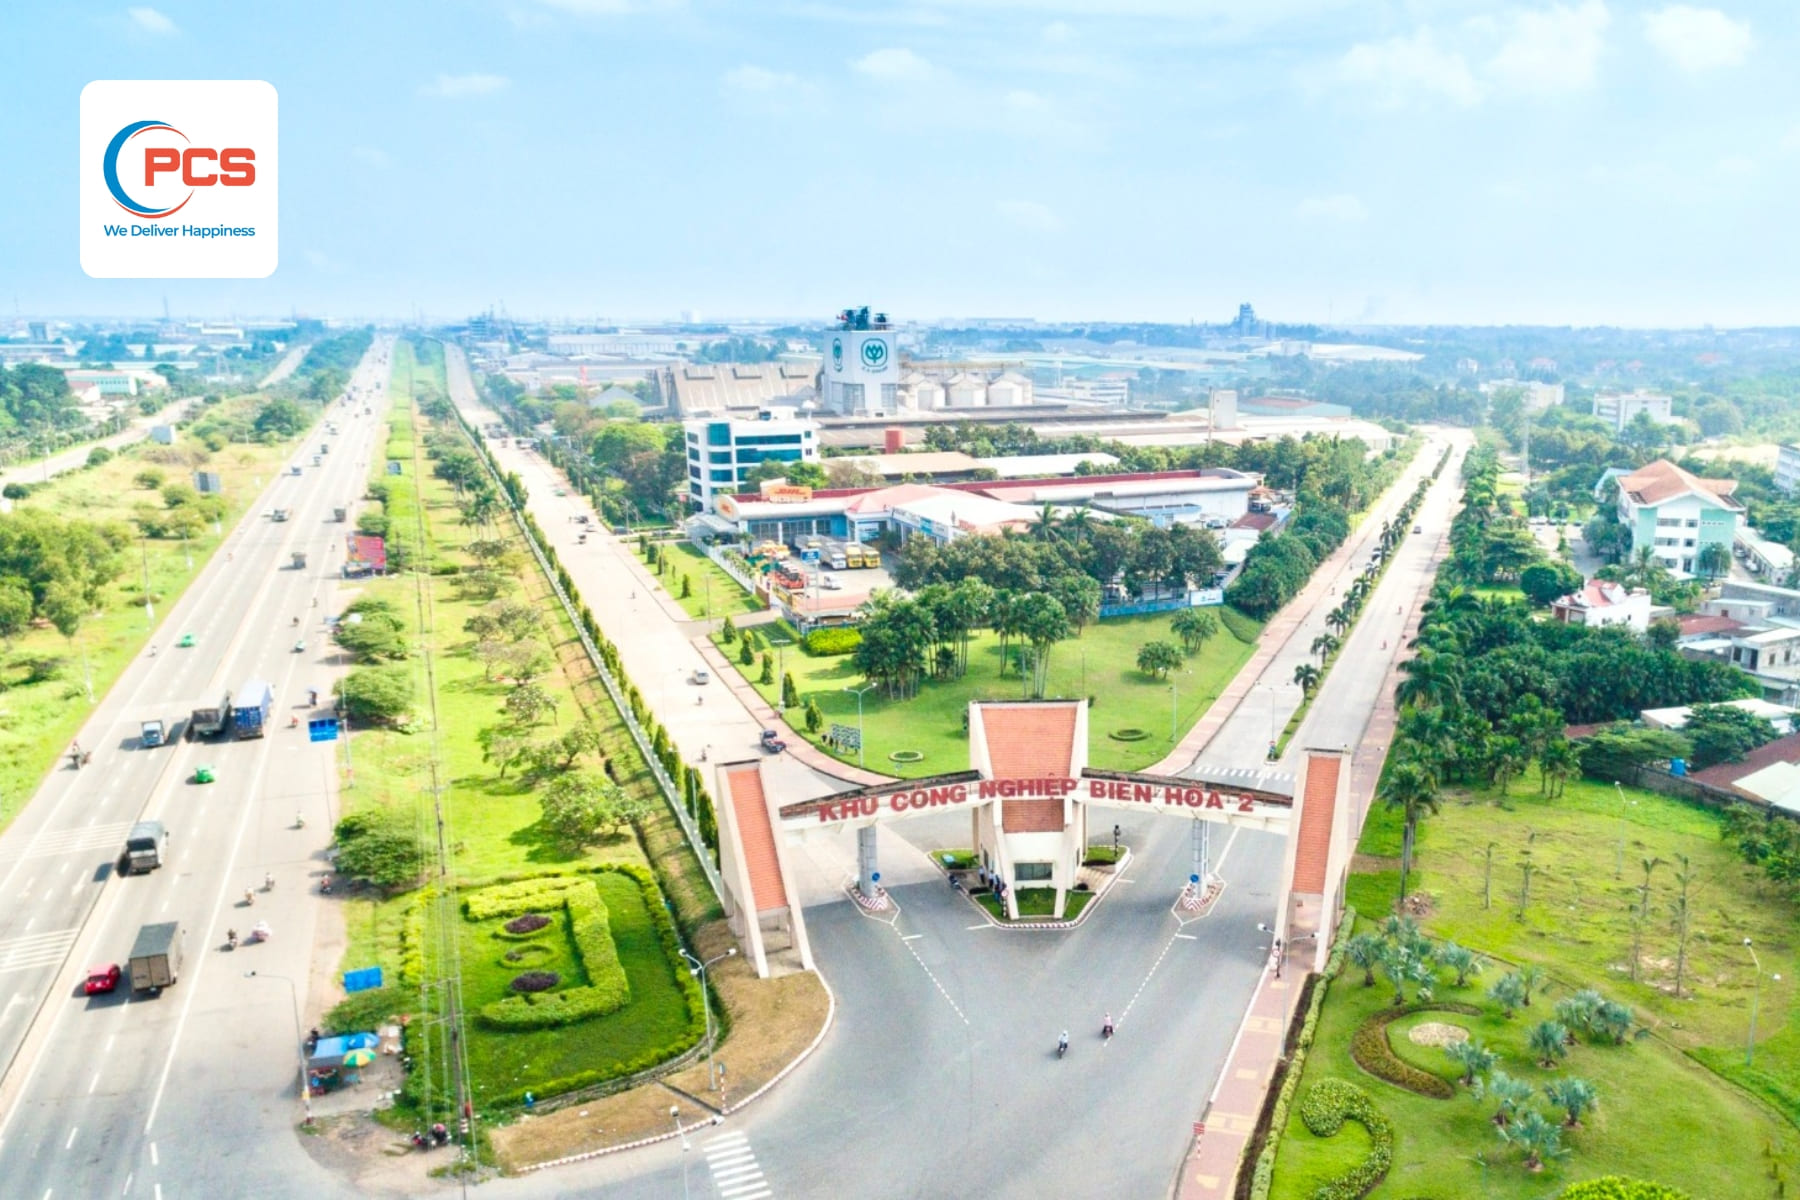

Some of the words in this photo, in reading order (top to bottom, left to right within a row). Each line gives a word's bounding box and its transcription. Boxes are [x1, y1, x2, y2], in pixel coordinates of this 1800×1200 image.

[819, 795, 878, 822] KHU
[890, 783, 967, 811] CÔNG
[1090, 775, 1151, 803] BIÊN
[1238, 793, 1254, 812] 2
